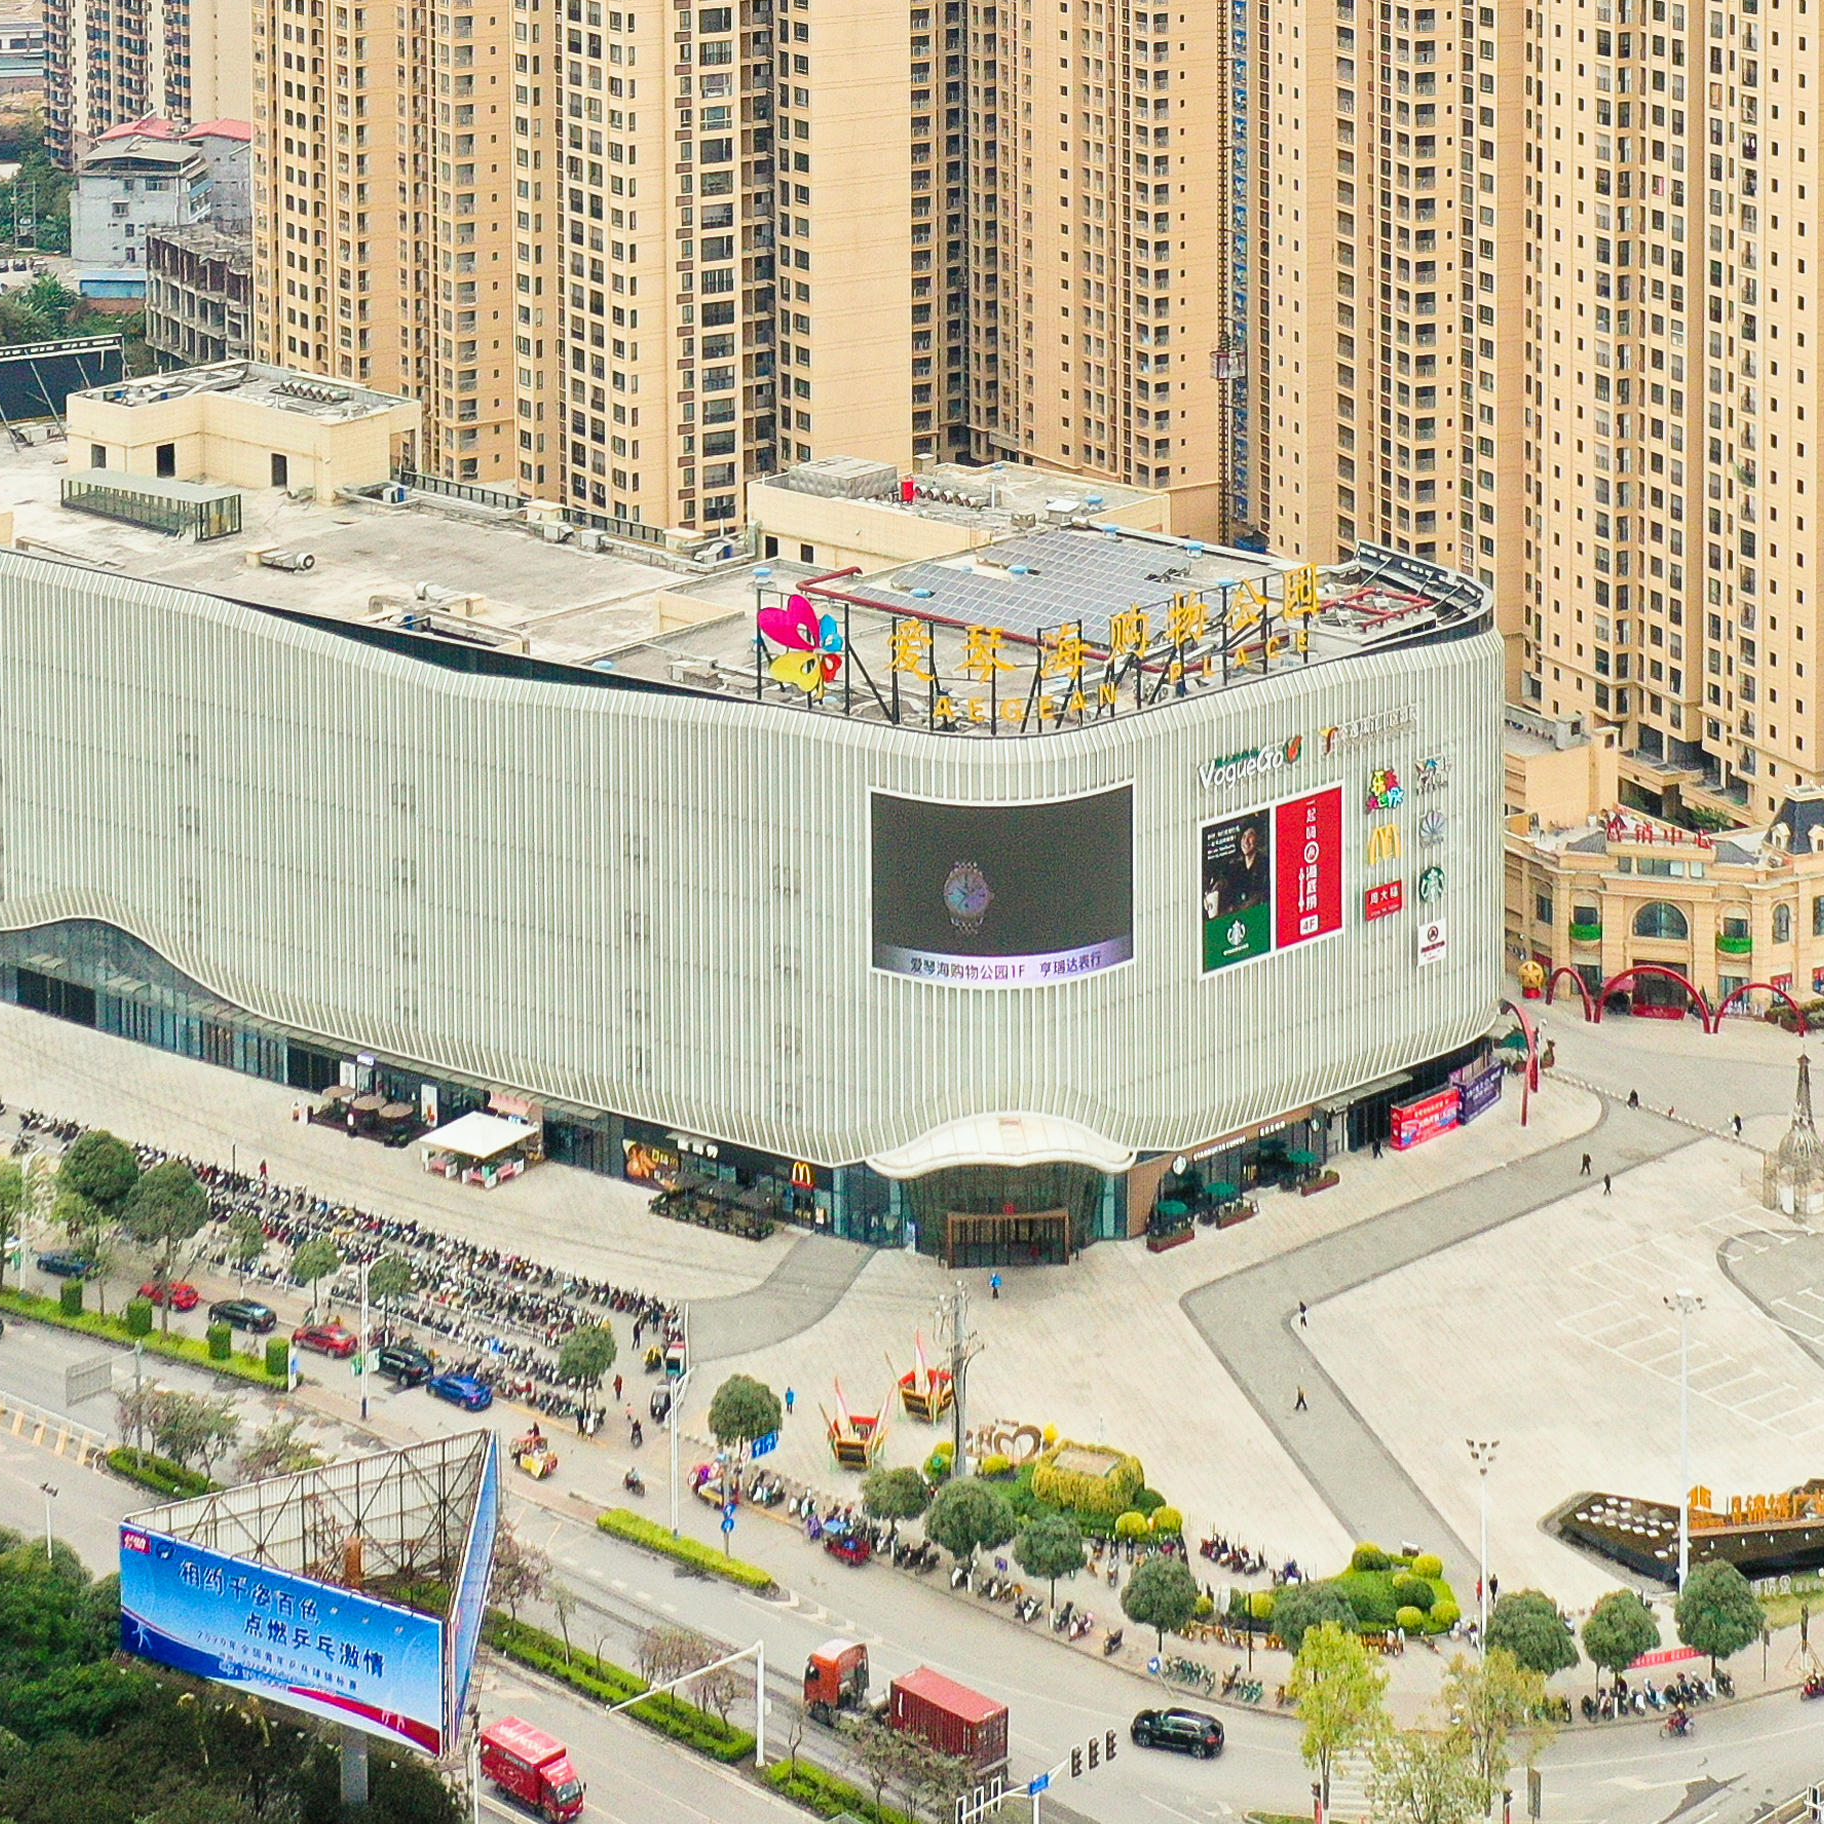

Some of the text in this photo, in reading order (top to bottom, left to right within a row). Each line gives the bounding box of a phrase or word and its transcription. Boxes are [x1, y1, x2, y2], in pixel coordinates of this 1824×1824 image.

[886, 562, 1318, 684] 爱琴海购物公园
[933, 629, 1310, 722] AEGEAN PLACE
[1198, 746, 1284, 790] VogueGo
[1369, 887, 1399, 906] 周大福
[910, 957, 1026, 981] 爱琴海购物公园1F
[244, 1612, 385, 1678] 点燃乒乓激情
